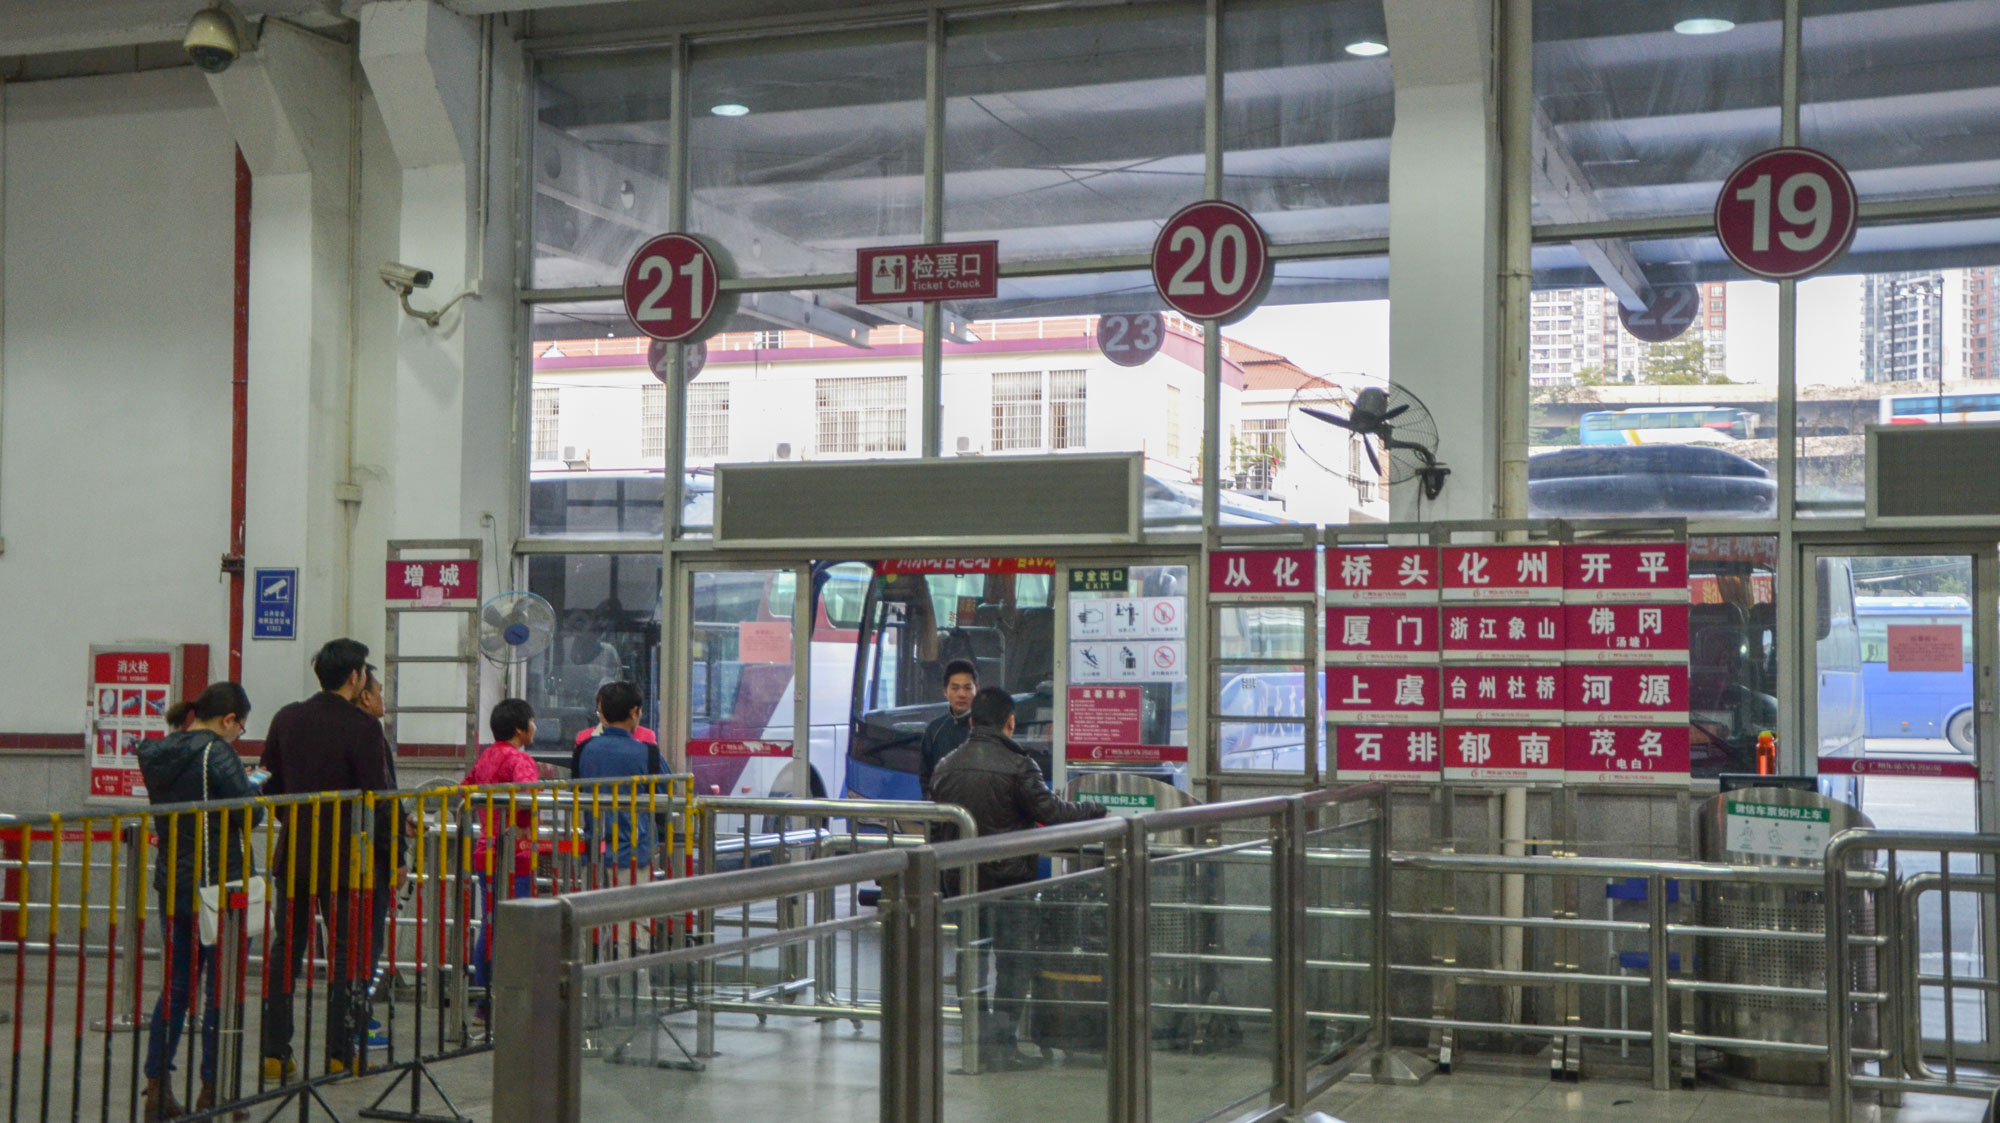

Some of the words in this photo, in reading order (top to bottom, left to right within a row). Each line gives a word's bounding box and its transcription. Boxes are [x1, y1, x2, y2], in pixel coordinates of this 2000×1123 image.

[1737, 172, 1832, 251] 19
[912, 253, 981, 279] 检票口
[1168, 224, 1247, 295] 20
[637, 253, 703, 320] 21
[911, 281, 943, 290] Ticket
[947, 279, 981, 289] Check
[1105, 314, 1158, 351] 23
[404, 564, 460, 587] 增城
[1074, 570, 1123, 581] 安全出口
[1224, 557, 1300, 587] 从化
[1341, 554, 1429, 586] 桥头
[1458, 552, 1548, 584] 化州
[1580, 552, 1669, 583] 开平
[1085, 582, 1111, 590] EXIT
[1342, 615, 1423, 646] 厦门
[1450, 617, 1555, 640] 浙江象山
[1588, 608, 1662, 635] 佛冈
[117, 660, 149, 674] 消火栓
[1342, 674, 1425, 706] 上虞
[1451, 676, 1556, 700] 台州杜桥
[1582, 674, 1671, 706] 河源
[1354, 731, 1438, 763] 石排
[1458, 732, 1551, 764] 郁南
[1589, 729, 1663, 757] 茂名
[1735, 803, 1822, 820] 微信车票如何上车
